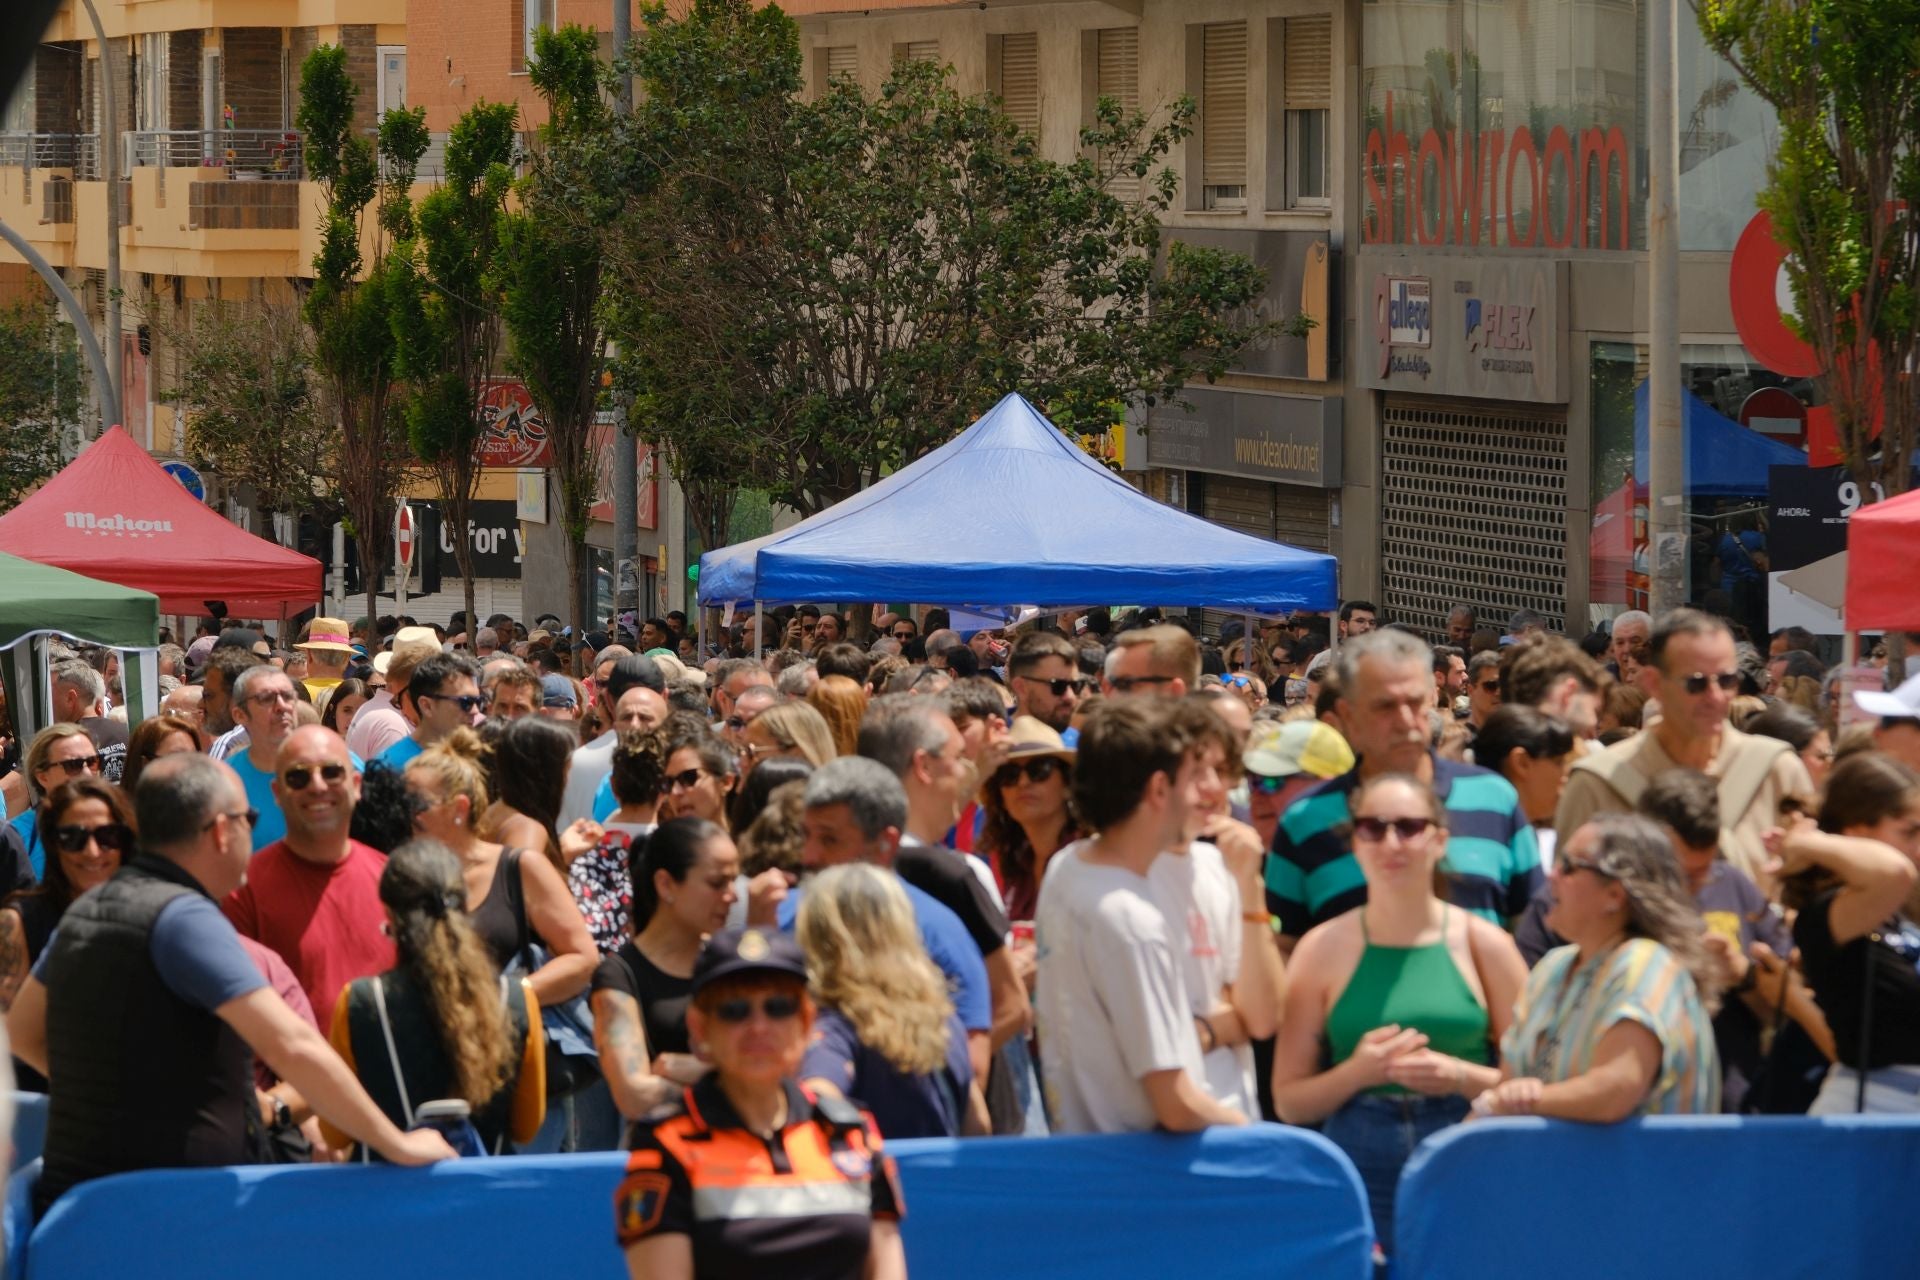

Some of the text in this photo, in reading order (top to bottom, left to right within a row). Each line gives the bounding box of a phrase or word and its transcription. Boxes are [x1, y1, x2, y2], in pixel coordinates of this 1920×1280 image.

[1365, 90, 1630, 250] showroom
[1482, 303, 1536, 350] FLEX
[1235, 432, 1320, 473] www.ideacolor.net
[64, 511, 174, 532] Mahou
